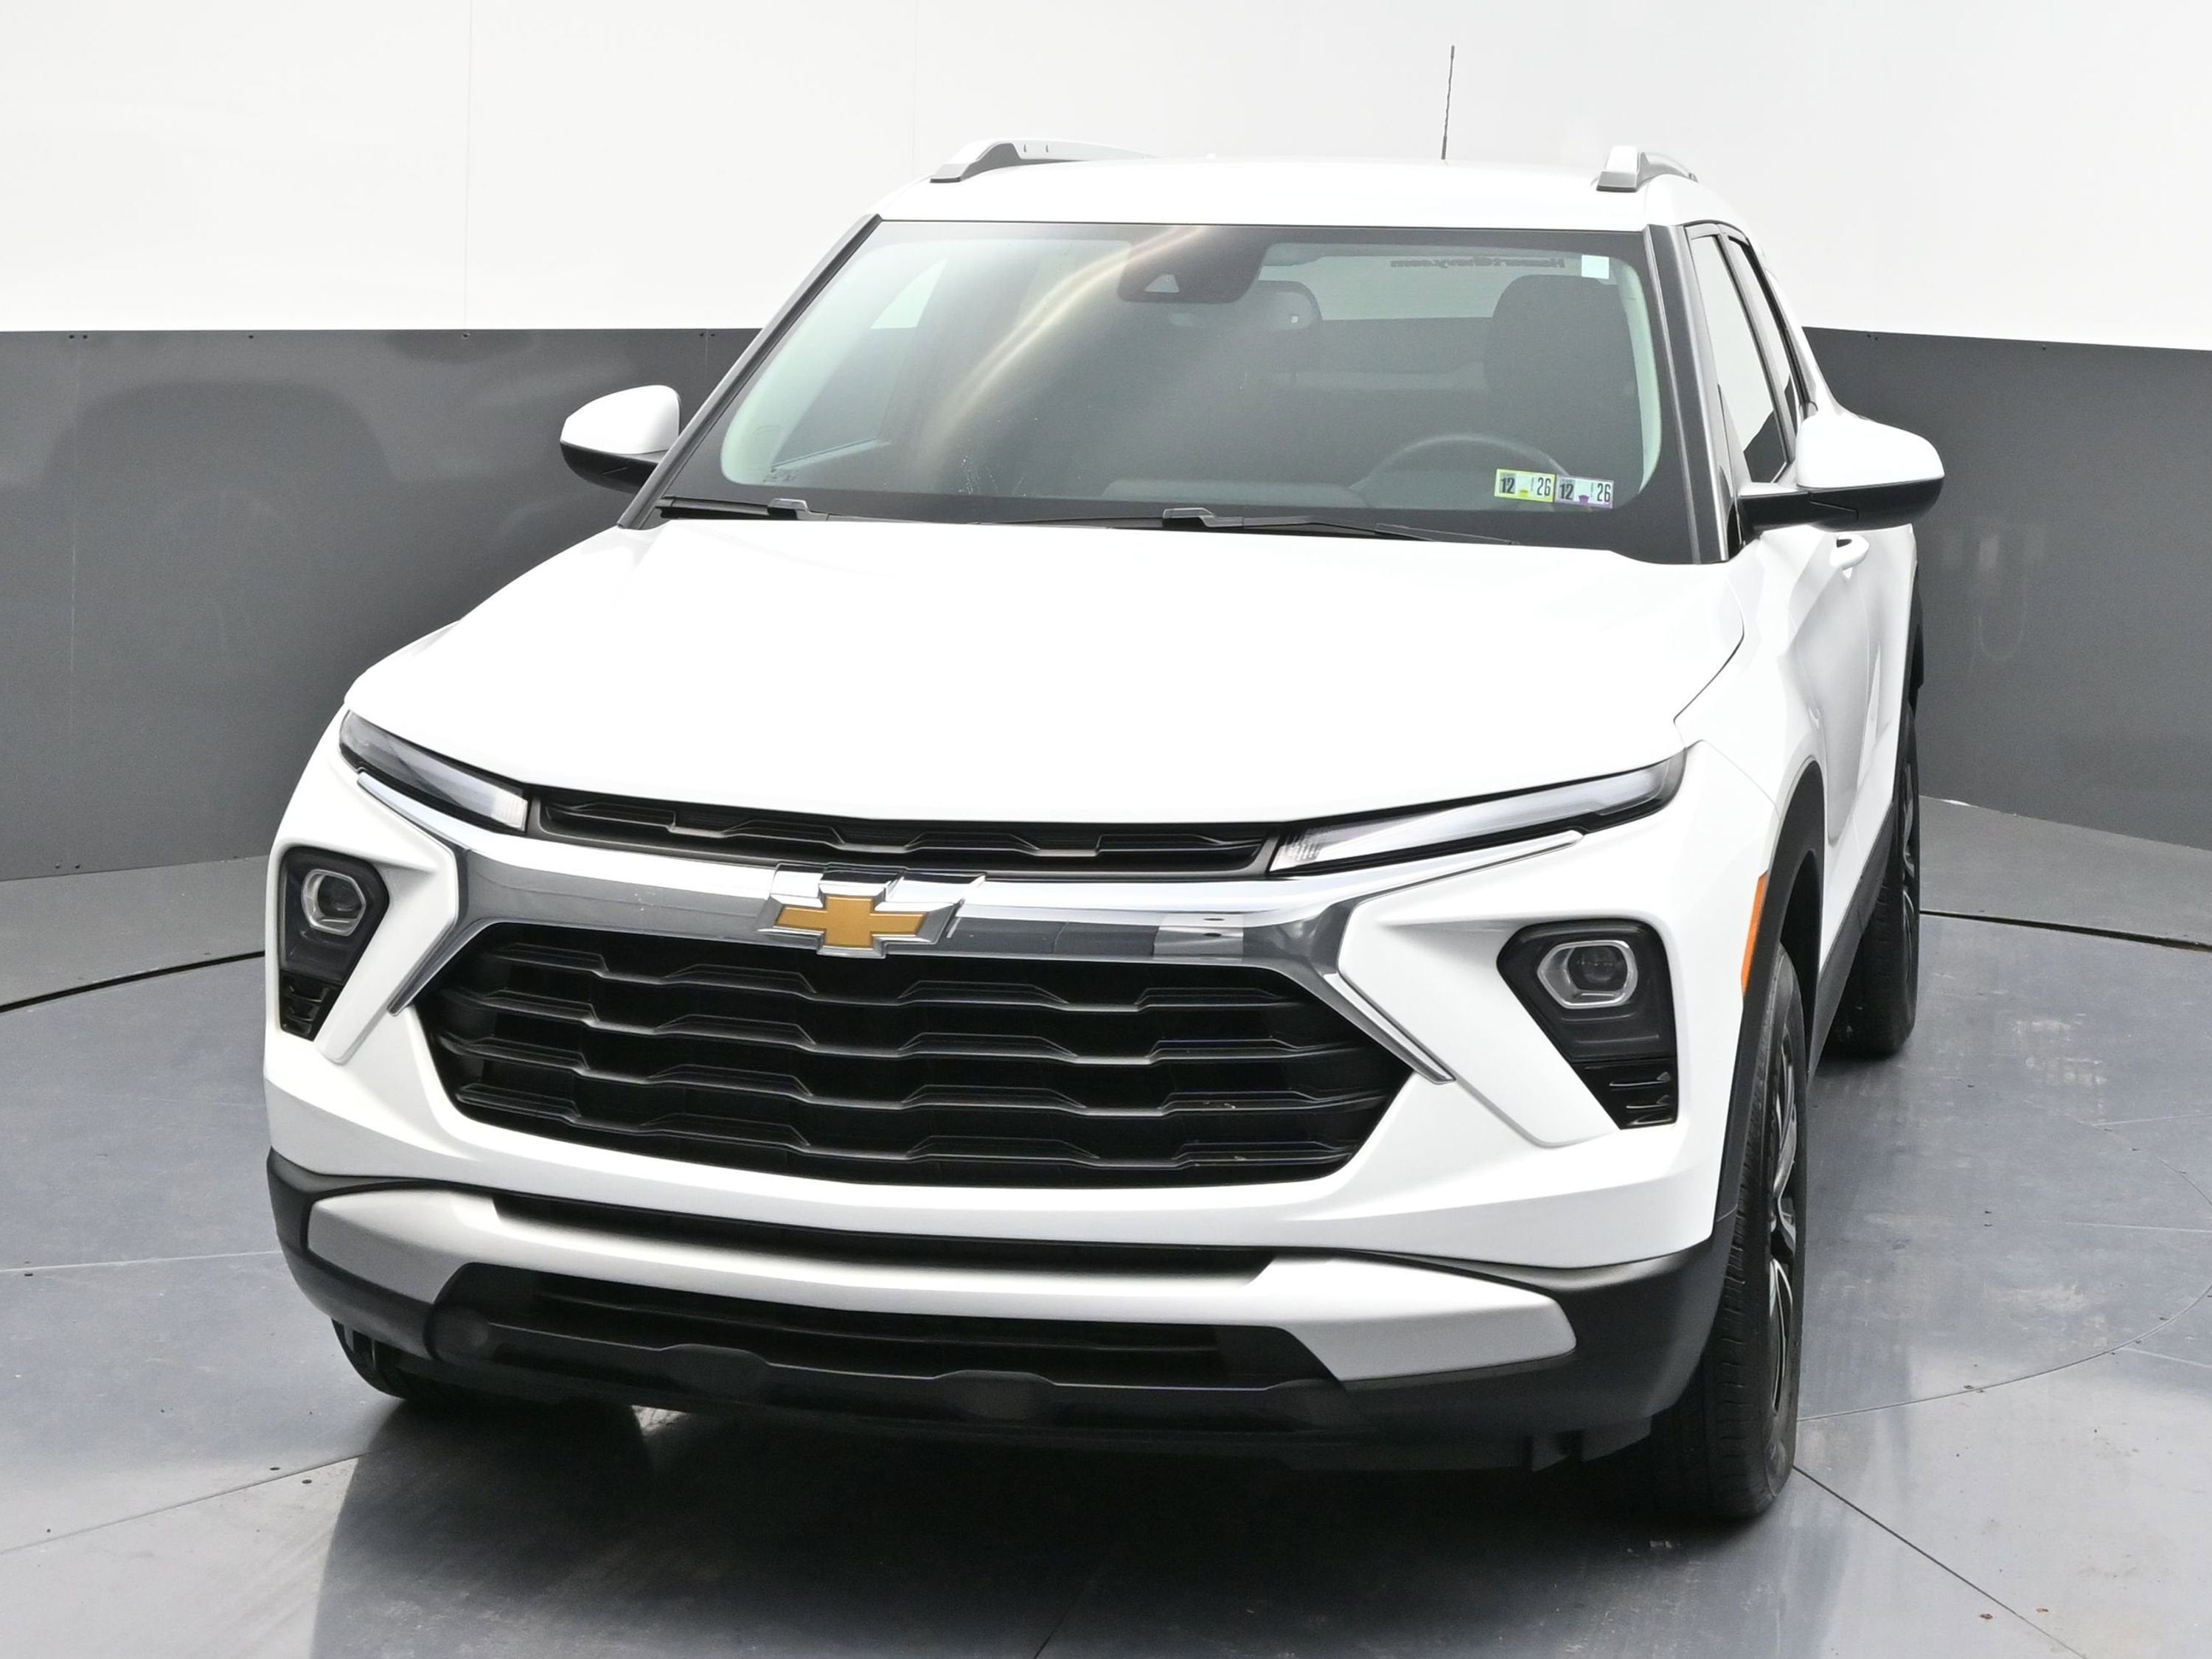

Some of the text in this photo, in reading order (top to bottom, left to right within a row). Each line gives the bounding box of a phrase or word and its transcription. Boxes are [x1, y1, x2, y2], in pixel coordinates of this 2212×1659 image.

[1500, 477, 1515, 494] 12
[1537, 477, 1551, 496] 26
[1559, 483, 1573, 500] 12
[1597, 483, 1611, 502] 26
